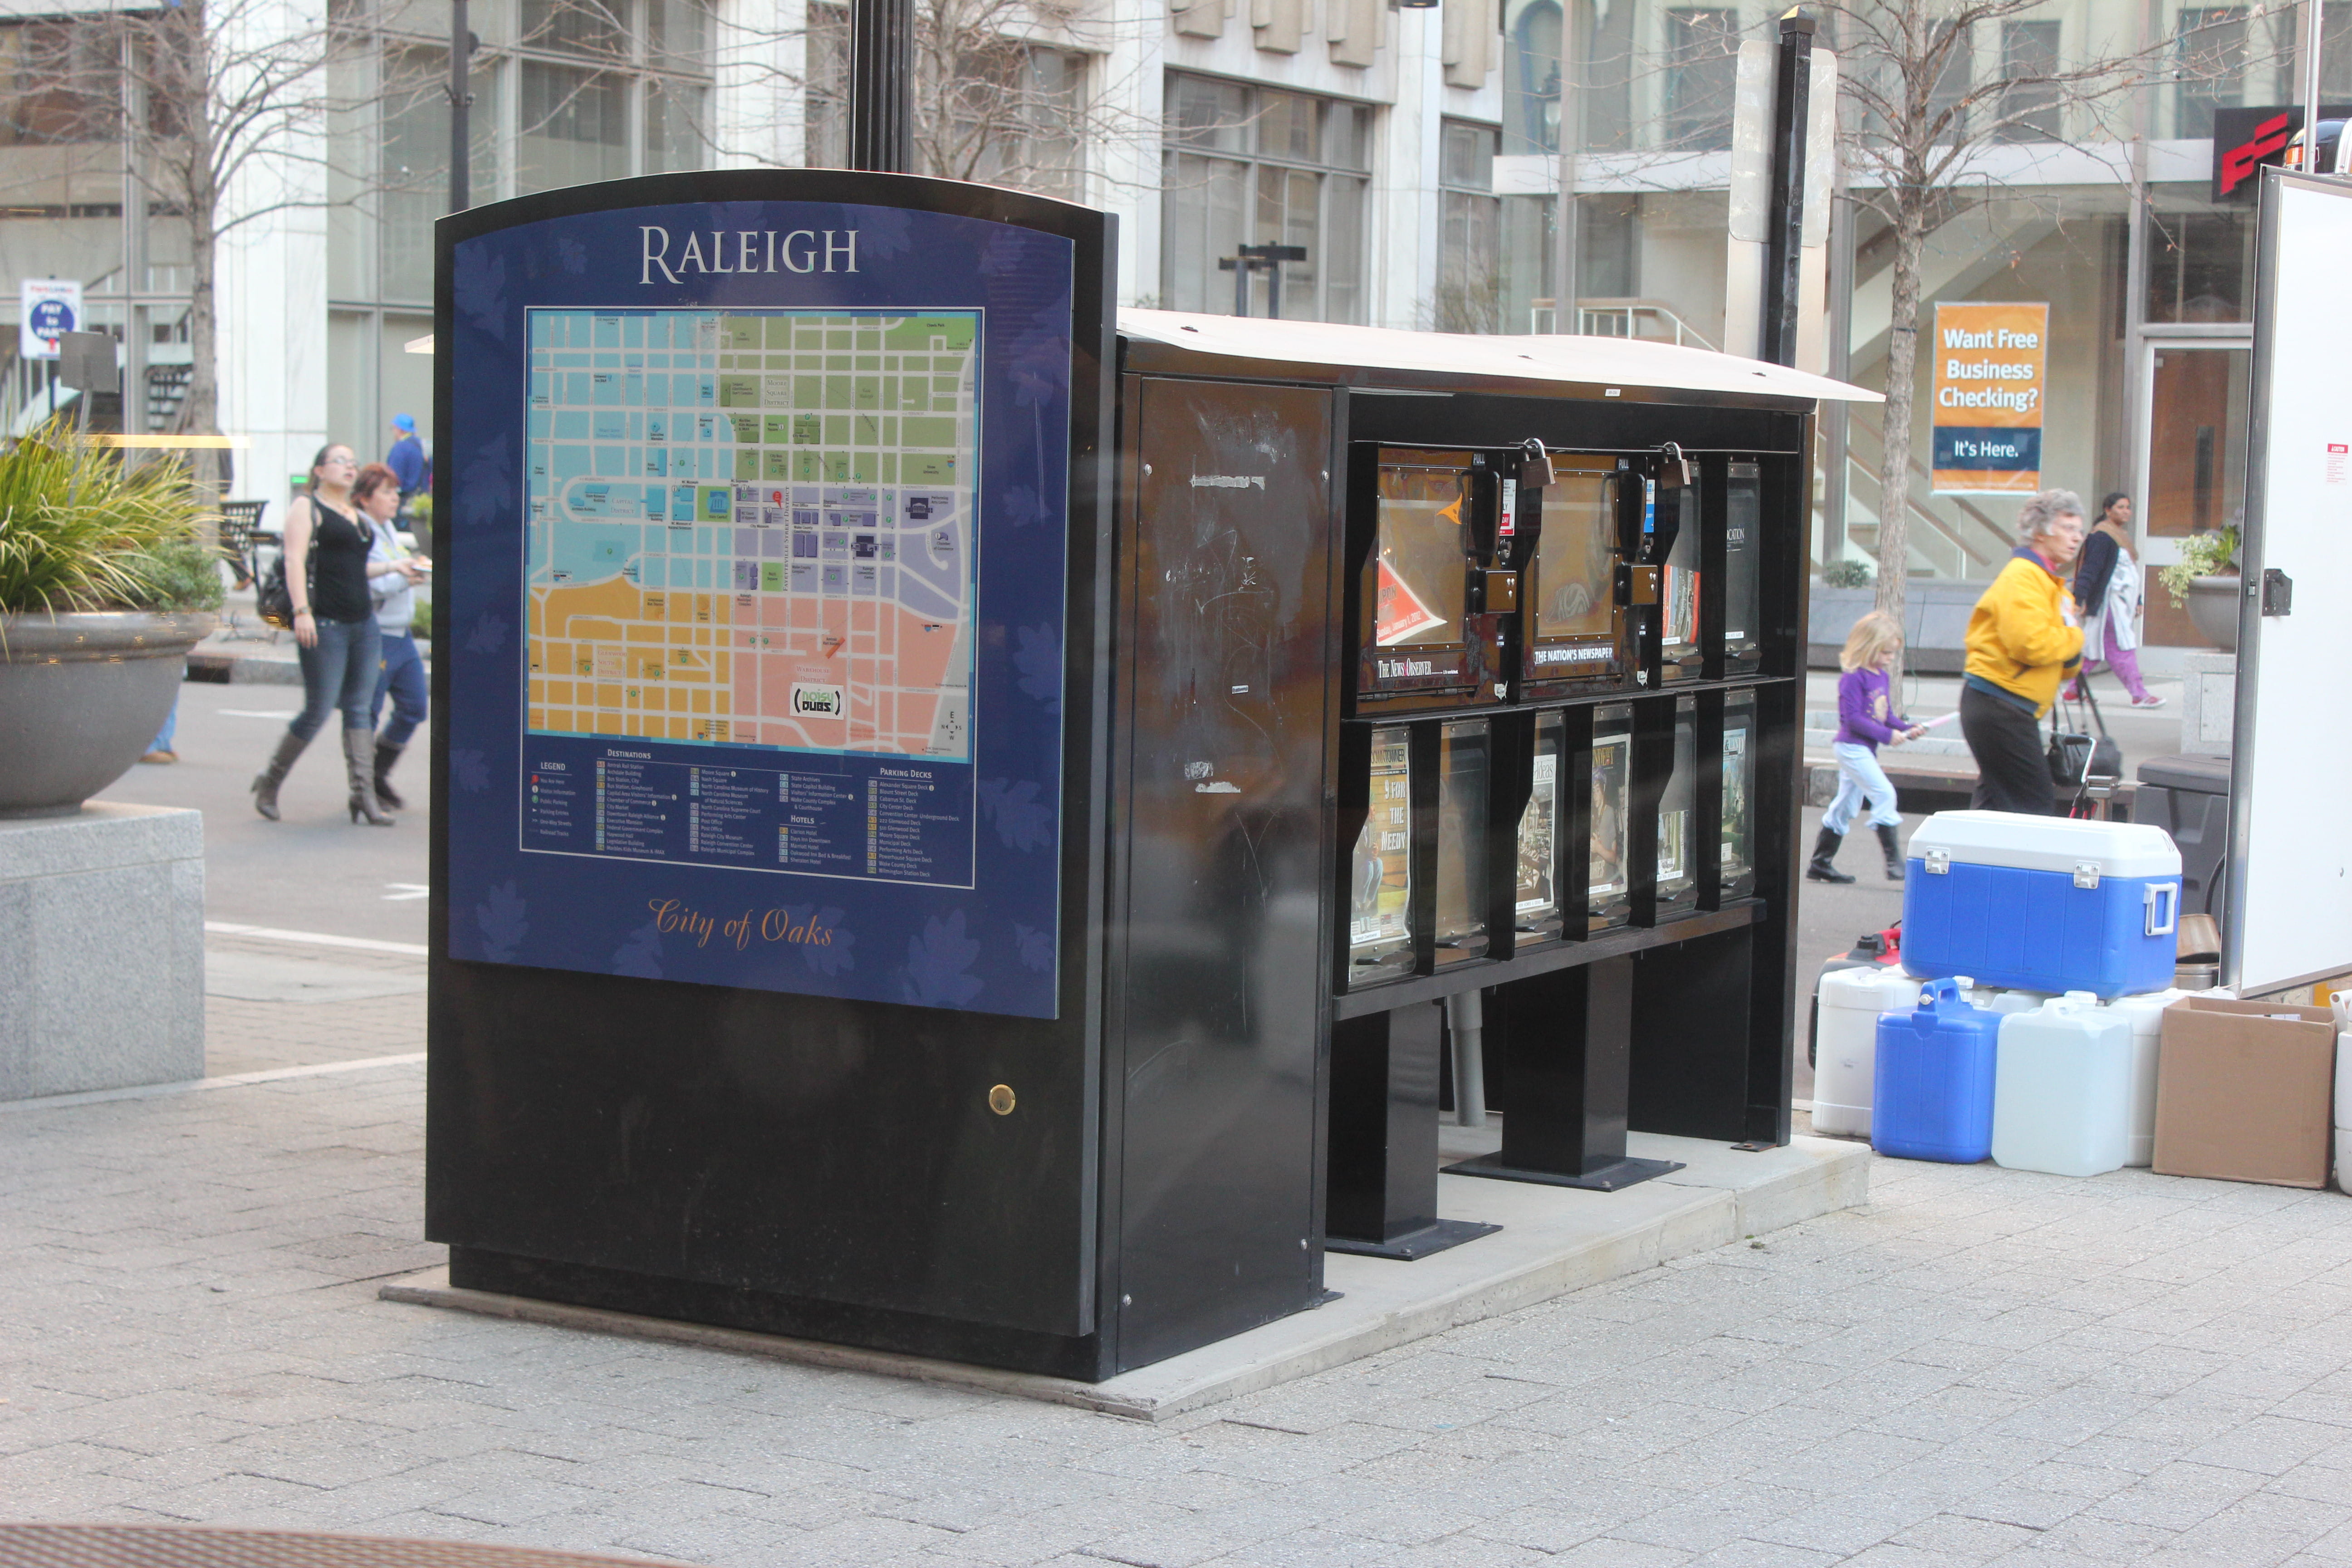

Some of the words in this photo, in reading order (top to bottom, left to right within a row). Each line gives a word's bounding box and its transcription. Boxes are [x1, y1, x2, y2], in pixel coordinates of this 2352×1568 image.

[639, 226, 859, 284] RALEIGH
[40, 303, 63, 315] PAY
[1944, 328, 1994, 349] Want
[1998, 328, 2038, 349] Free
[1946, 359, 2034, 379] Business
[1939, 387, 2038, 412] Checking?
[1955, 440, 1977, 457] It's
[1980, 441, 2019, 458] Here.
[1473, 453, 1485, 463] PULL
[1618, 459, 1629, 469] PULL
[1535, 651, 1547, 662] THE
[1548, 649, 1577, 662] NATION'S
[1578, 647, 1612, 660] NEWSPAPER
[1378, 660, 1389, 678] THE
[1391, 659, 1404, 677] NEWS
[1406, 657, 1432, 676] OBSERVER
[802, 701, 831, 712] DUBS
[608, 749, 651, 759] DESTINATIONS
[541, 762, 565, 770] LEGEND
[880, 768, 909, 777] PARKING
[911, 769, 932, 779] DECKS
[1537, 761, 1553, 779] Ideas
[1385, 779, 1389, 799] 9
[1392, 781, 1406, 799] FOR
[791, 815, 814, 824] HOTELS
[1390, 807, 1404, 824] THE
[1381, 831, 1406, 851] NEEDY
[649, 899, 714, 948] City
[725, 910, 753, 951] of
[762, 909, 832, 946] Oaks
